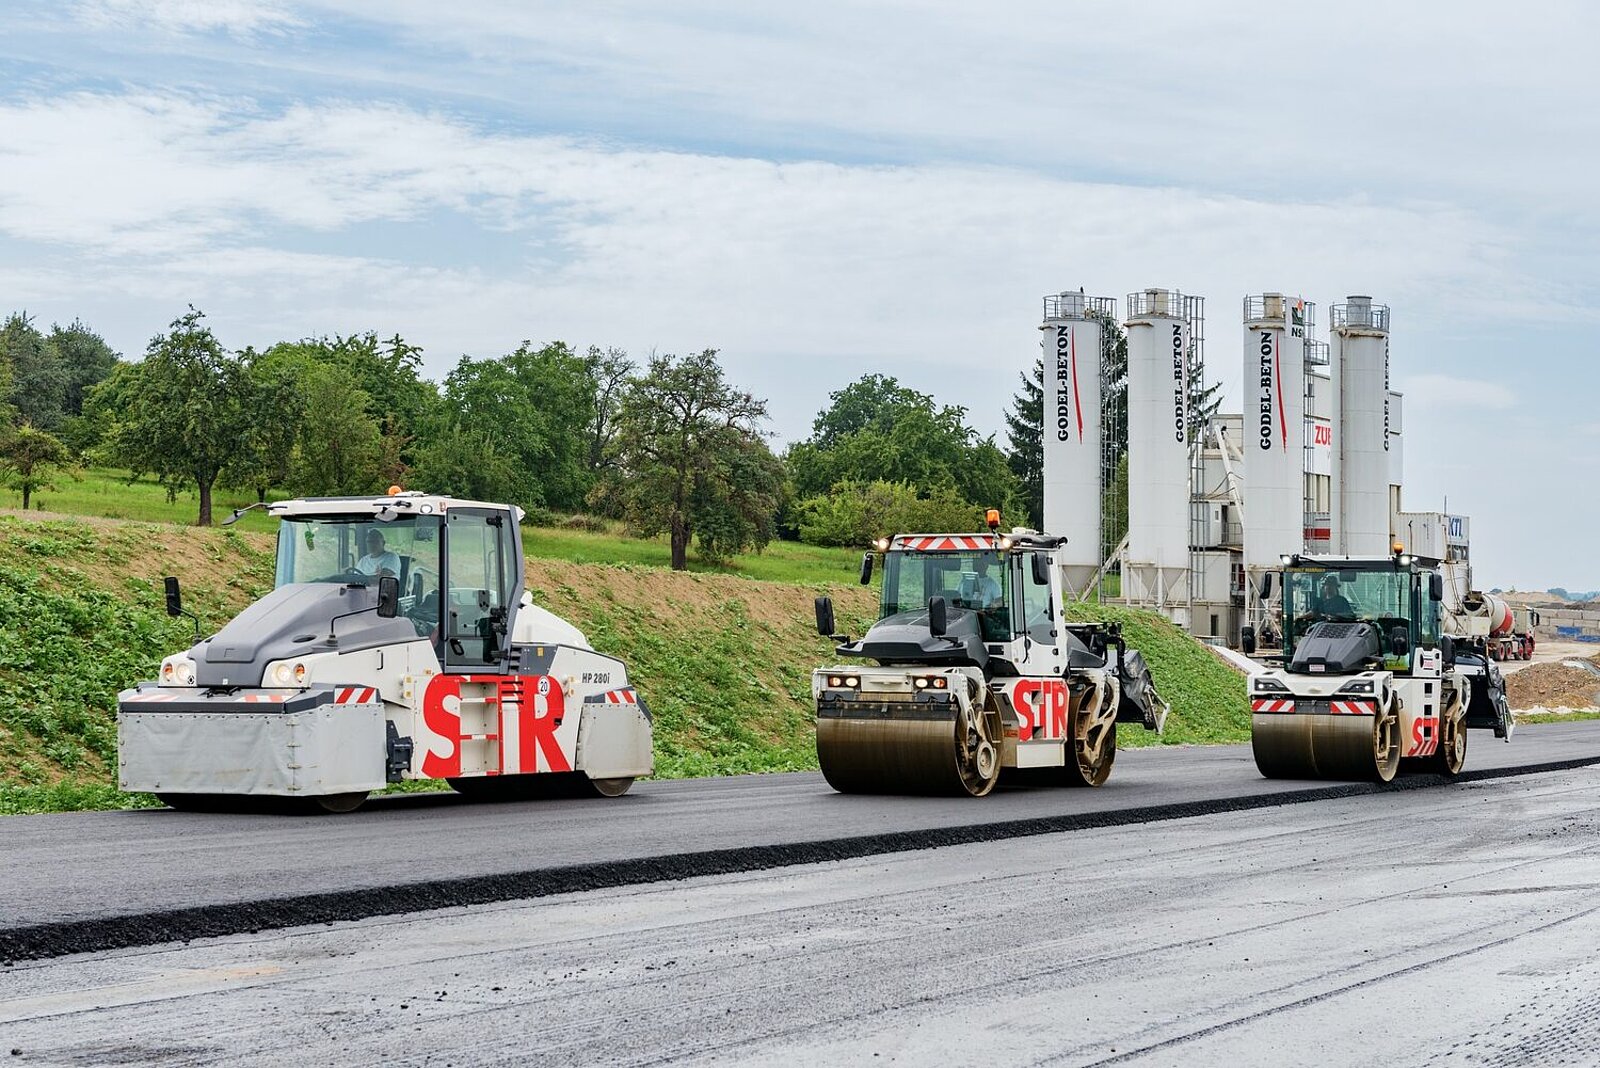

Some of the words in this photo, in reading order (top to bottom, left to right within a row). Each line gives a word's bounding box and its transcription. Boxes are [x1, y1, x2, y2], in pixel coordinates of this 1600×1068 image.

[1057, 325, 1069, 441] GODEL-BETON
[1172, 324, 1184, 442] GODEL-BETON
[1260, 331, 1272, 450] GODEL-BETON
[540, 681, 548, 690] 20
[582, 673, 593, 684] HP
[594, 672, 610, 684] 280i
